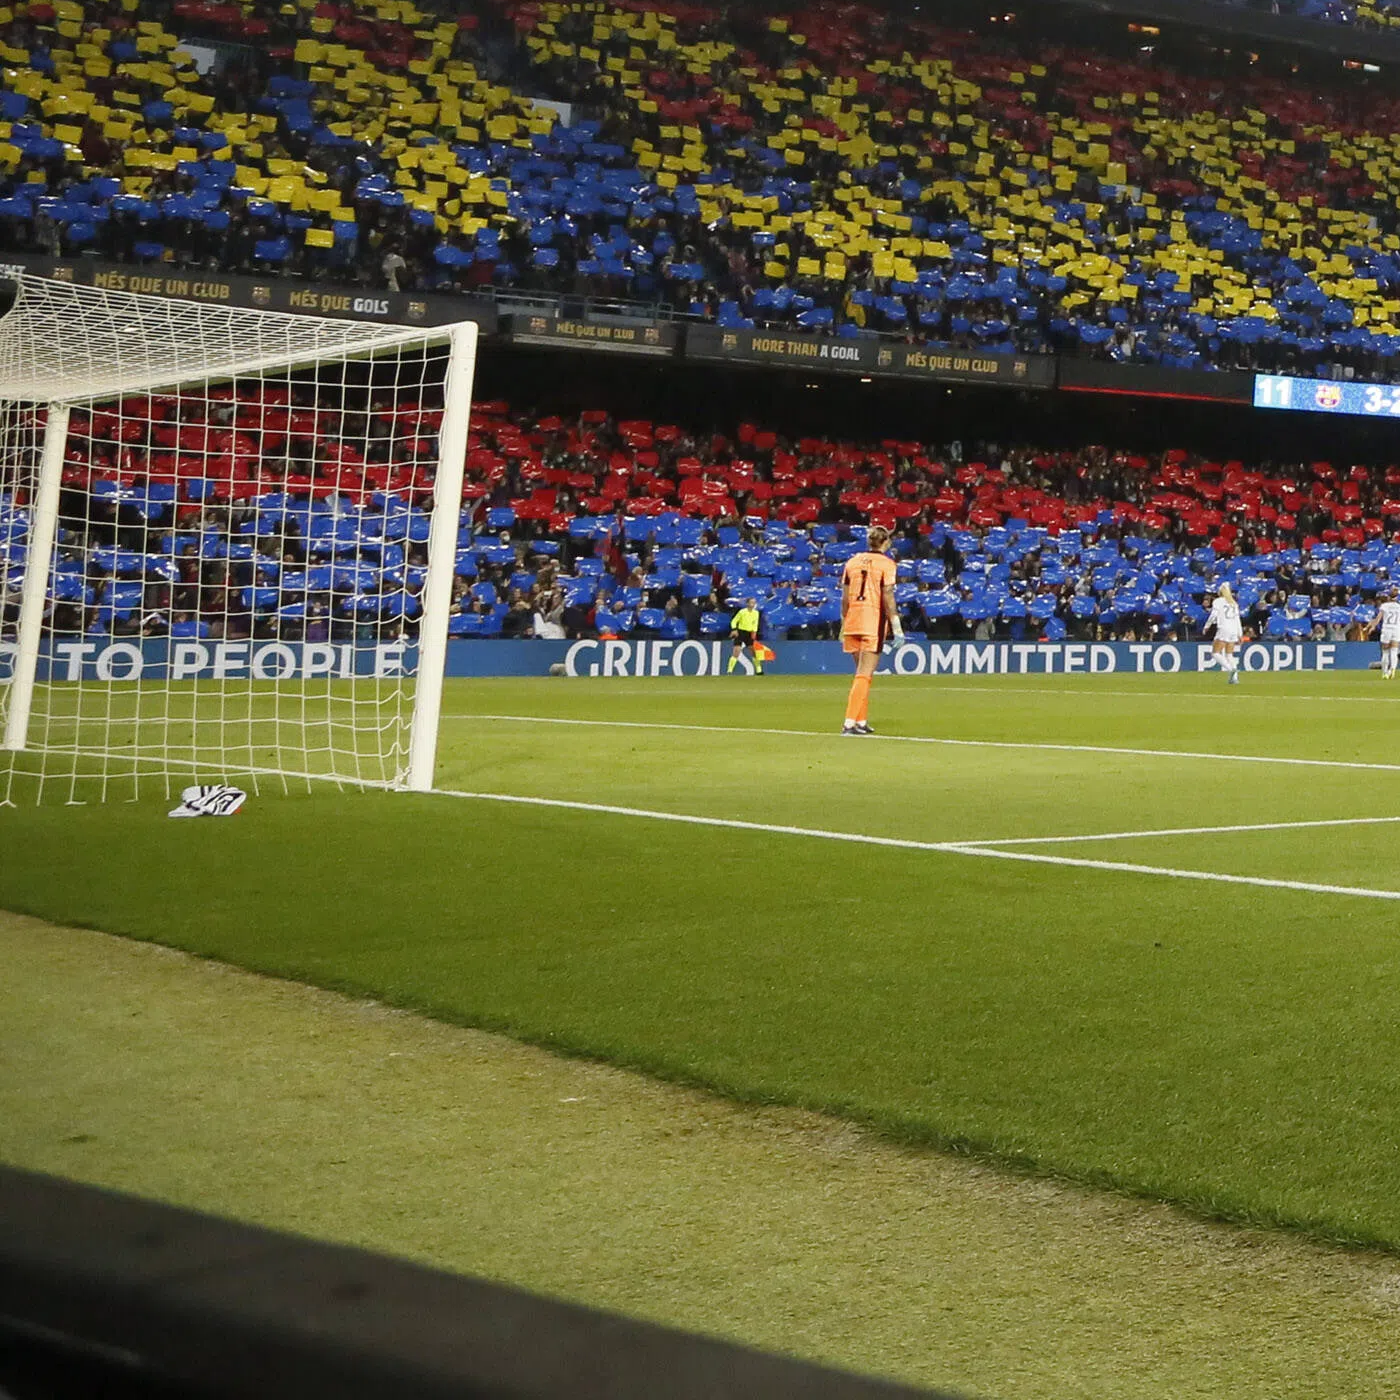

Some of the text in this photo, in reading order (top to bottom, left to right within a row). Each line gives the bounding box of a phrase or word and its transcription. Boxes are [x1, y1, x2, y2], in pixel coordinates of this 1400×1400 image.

[94, 271, 230, 298] MÉS QUE UN CLUB
[289, 290, 389, 314] MÉS QUE GOLS
[556, 321, 635, 339] MÉS QUE UN CLUB
[752, 338, 860, 360] MORE THAN A GOAL
[906, 352, 998, 373] MÉS QUE UN CLUB
[1258, 378, 1291, 405] 11
[57, 643, 144, 681] TO
[173, 643, 407, 680] PEOPLE
[1129, 644, 1181, 673] TO
